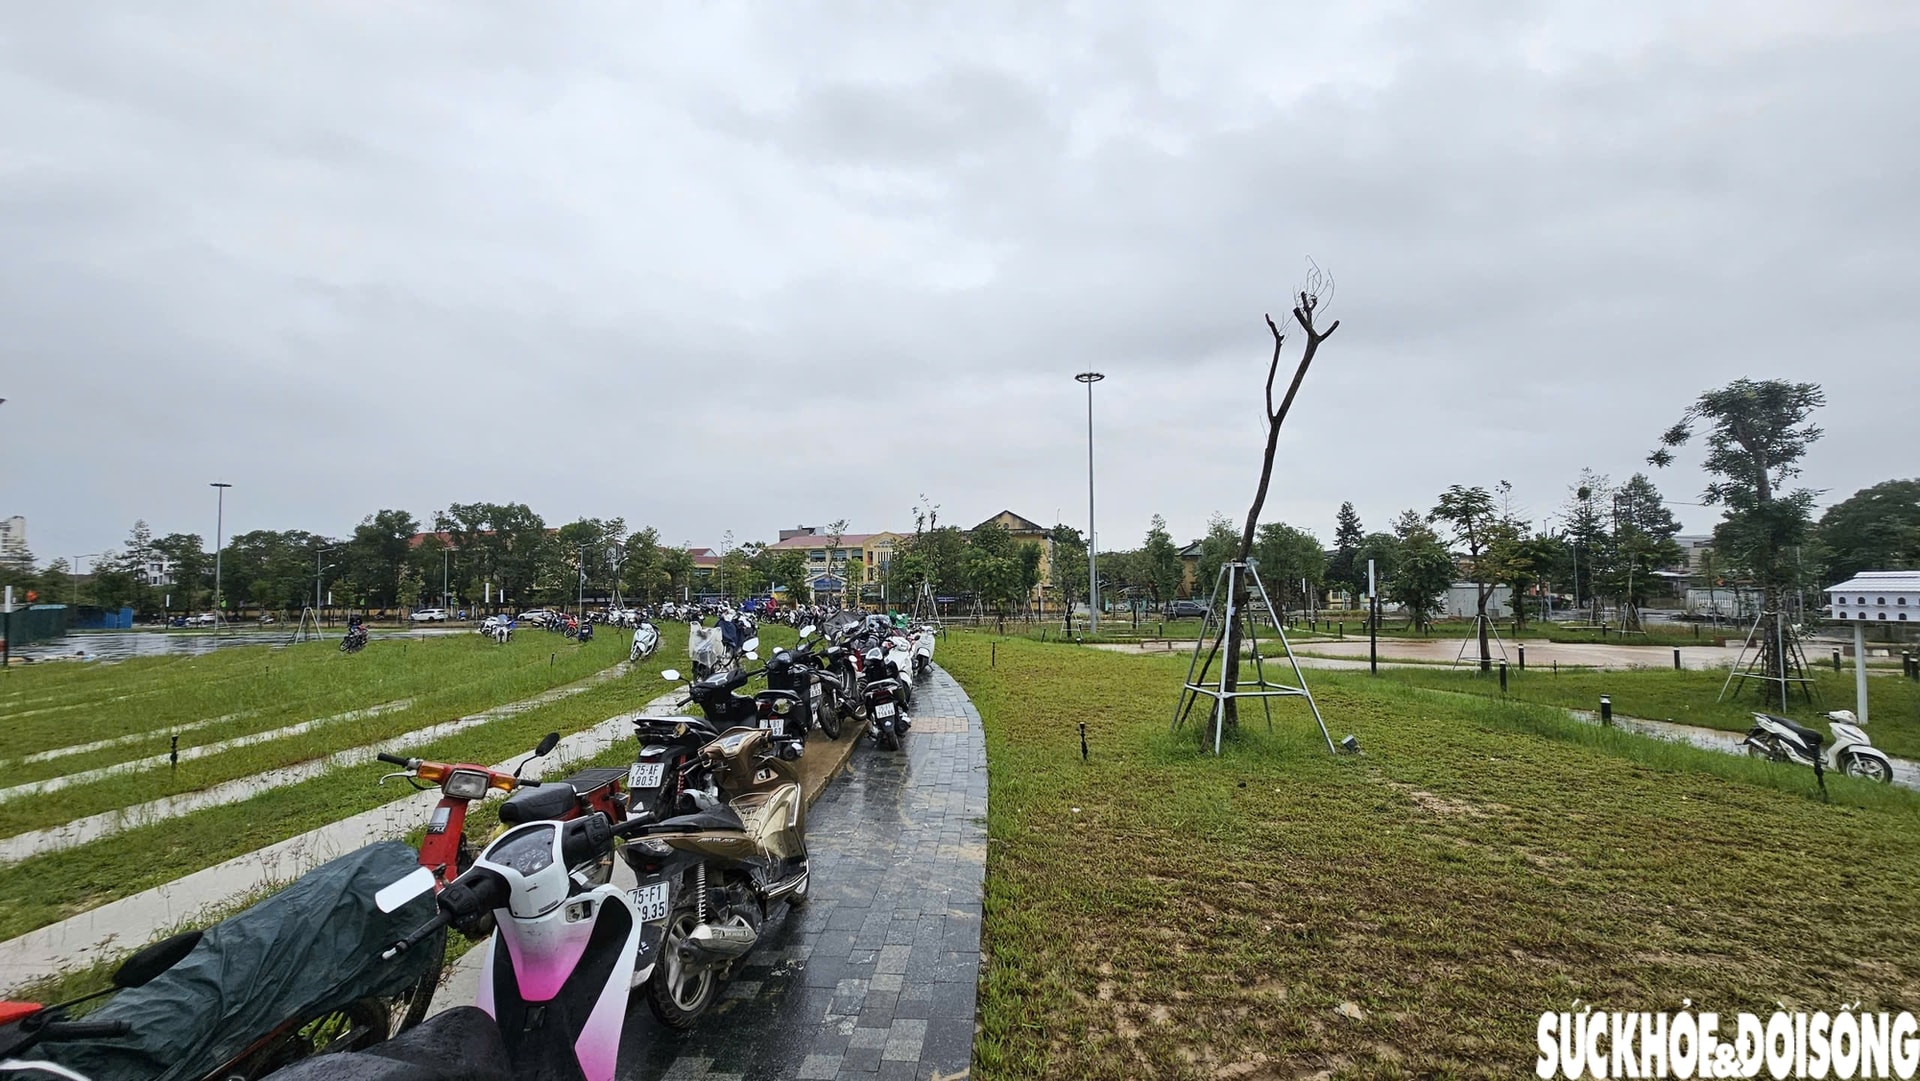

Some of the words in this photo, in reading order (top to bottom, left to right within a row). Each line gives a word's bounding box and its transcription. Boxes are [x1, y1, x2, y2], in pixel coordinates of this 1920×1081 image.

[635, 765, 659, 775] 75-AF
[631, 776, 658, 786] 180.51
[632, 885, 661, 904] 75-F1
[637, 901, 665, 920] 9.35
